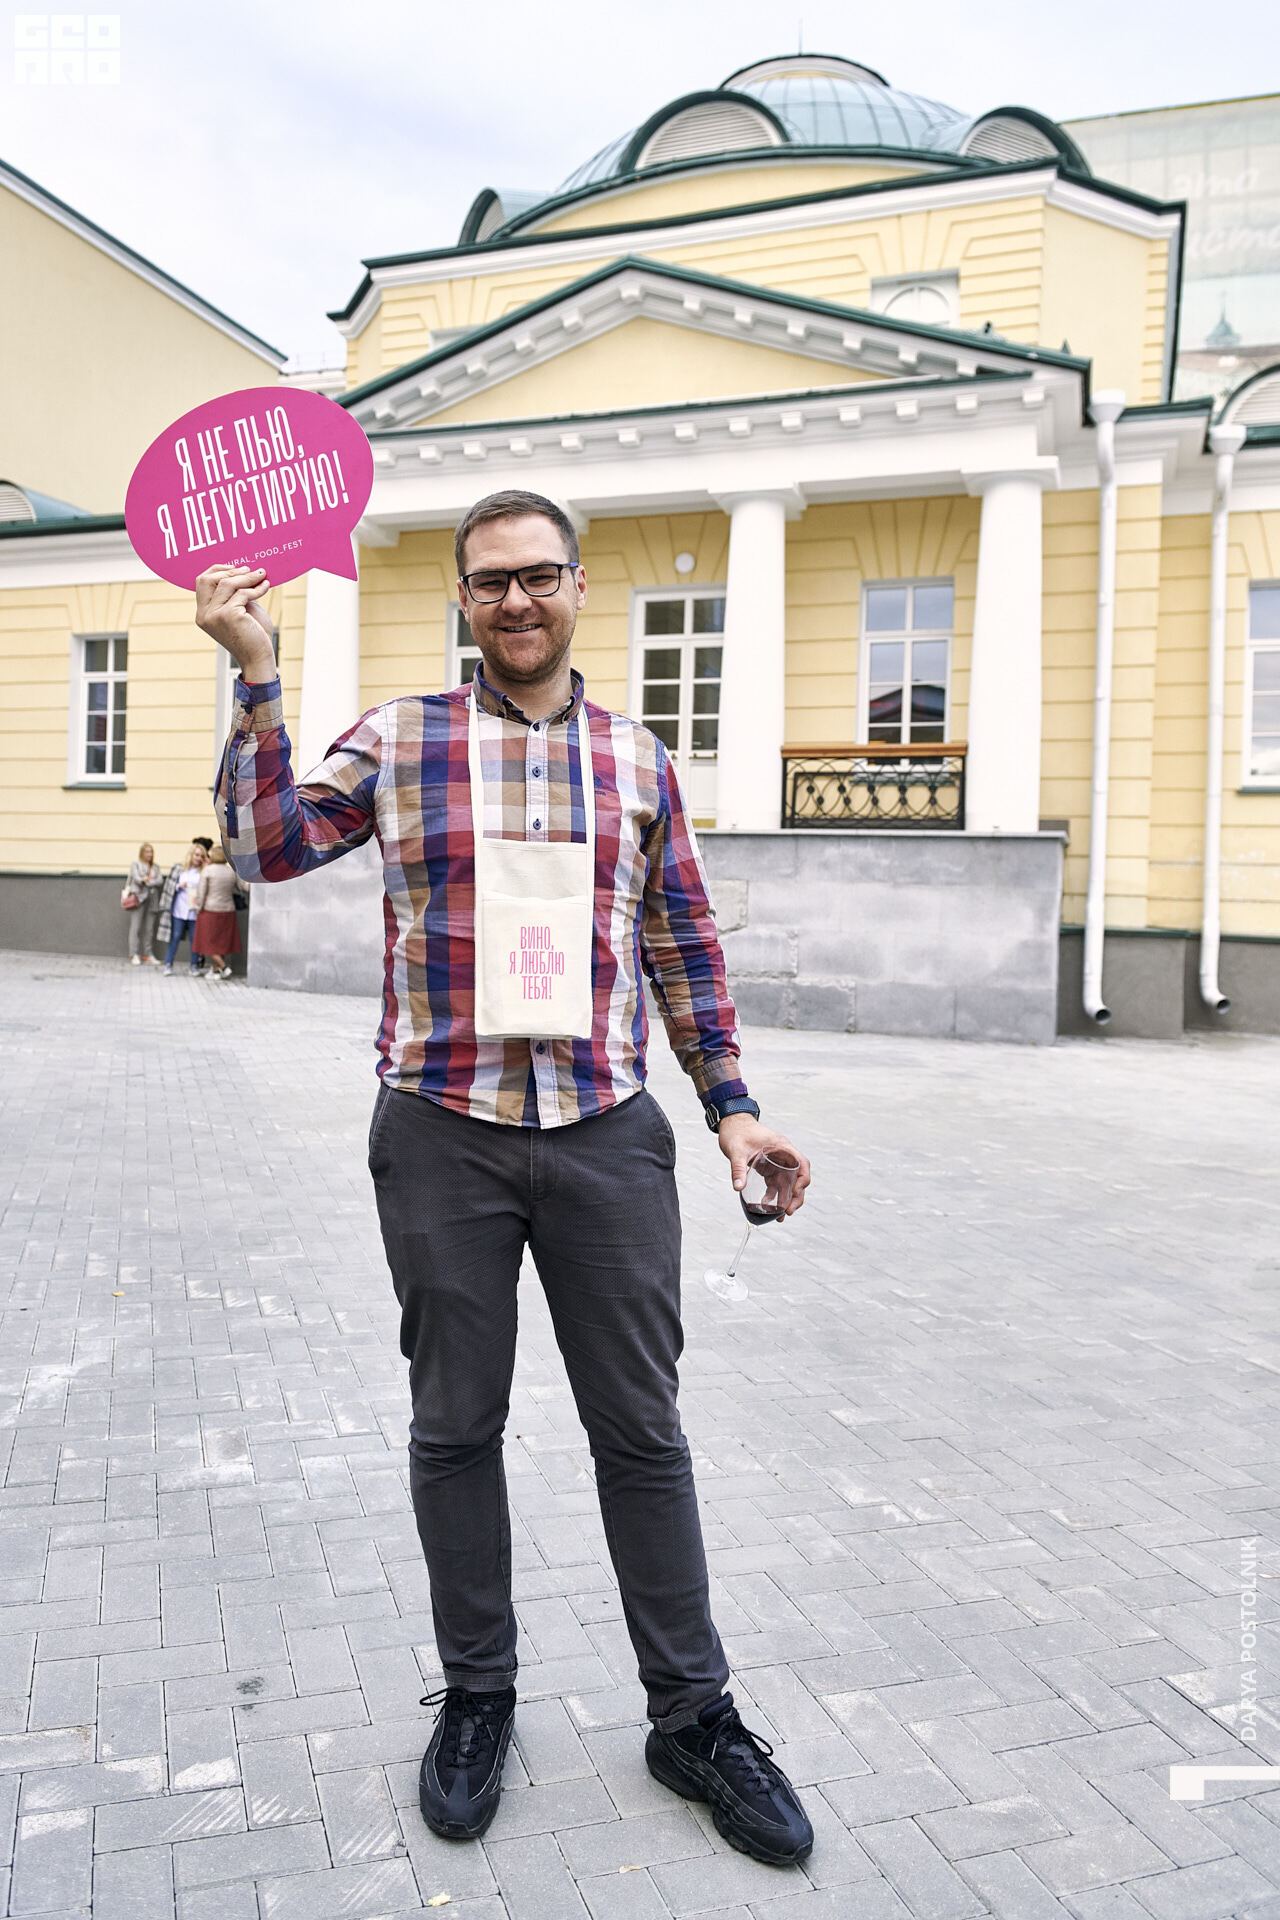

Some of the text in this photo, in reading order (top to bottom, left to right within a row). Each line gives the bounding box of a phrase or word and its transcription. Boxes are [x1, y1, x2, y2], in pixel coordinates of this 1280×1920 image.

[174, 405, 305, 493] Я НЕ ПЬЮ,
[156, 450, 350, 559] Я ДЕГУСТИРУЮ!
[224, 539, 303, 566] URAL_FOOD_FEST
[520, 926, 554, 951] ВИНО,
[509, 950, 565, 976] Я ЛЮБЛЮ
[521, 975, 552, 1000] ТЕБЯ!
